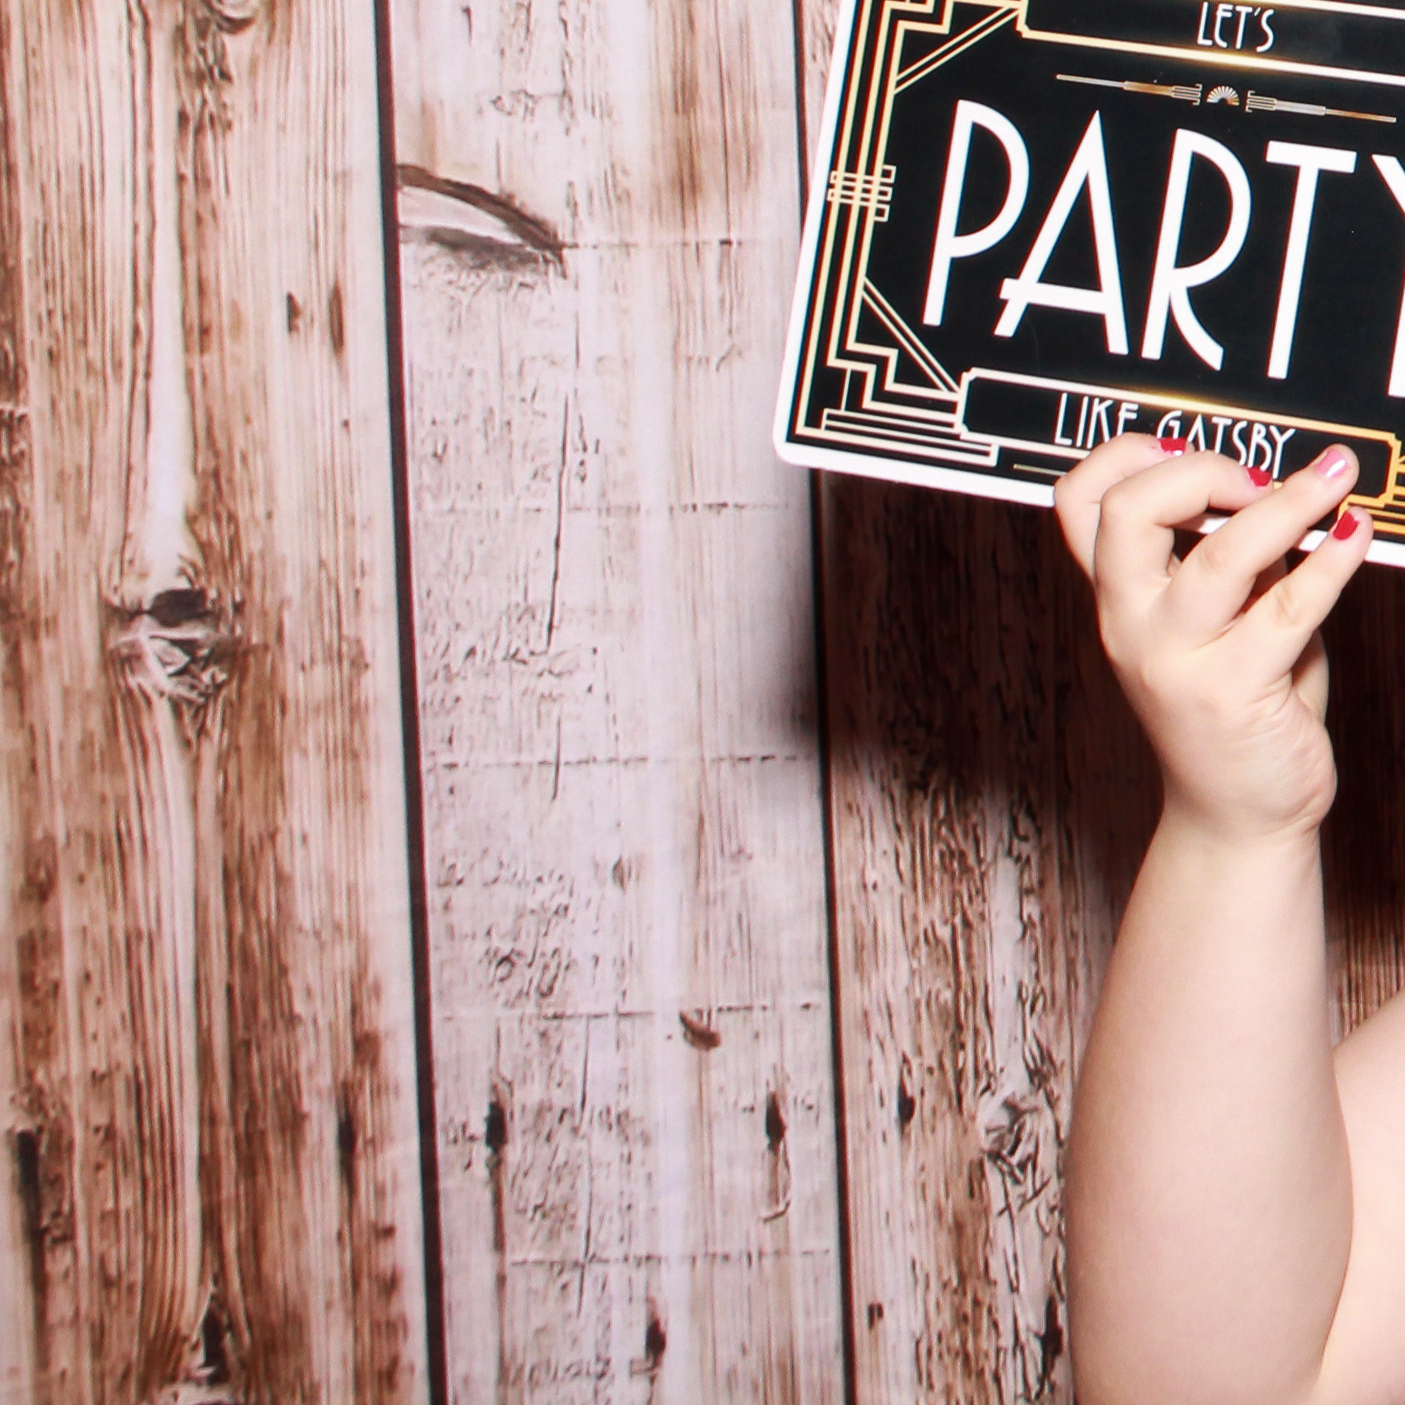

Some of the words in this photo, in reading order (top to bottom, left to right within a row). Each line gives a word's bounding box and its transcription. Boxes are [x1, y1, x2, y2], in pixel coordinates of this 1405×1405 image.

[1196, 0, 1275, 54] LET'S
[1053, 392, 1139, 451] LIKE
[1156, 410, 1297, 481] GATSBY
